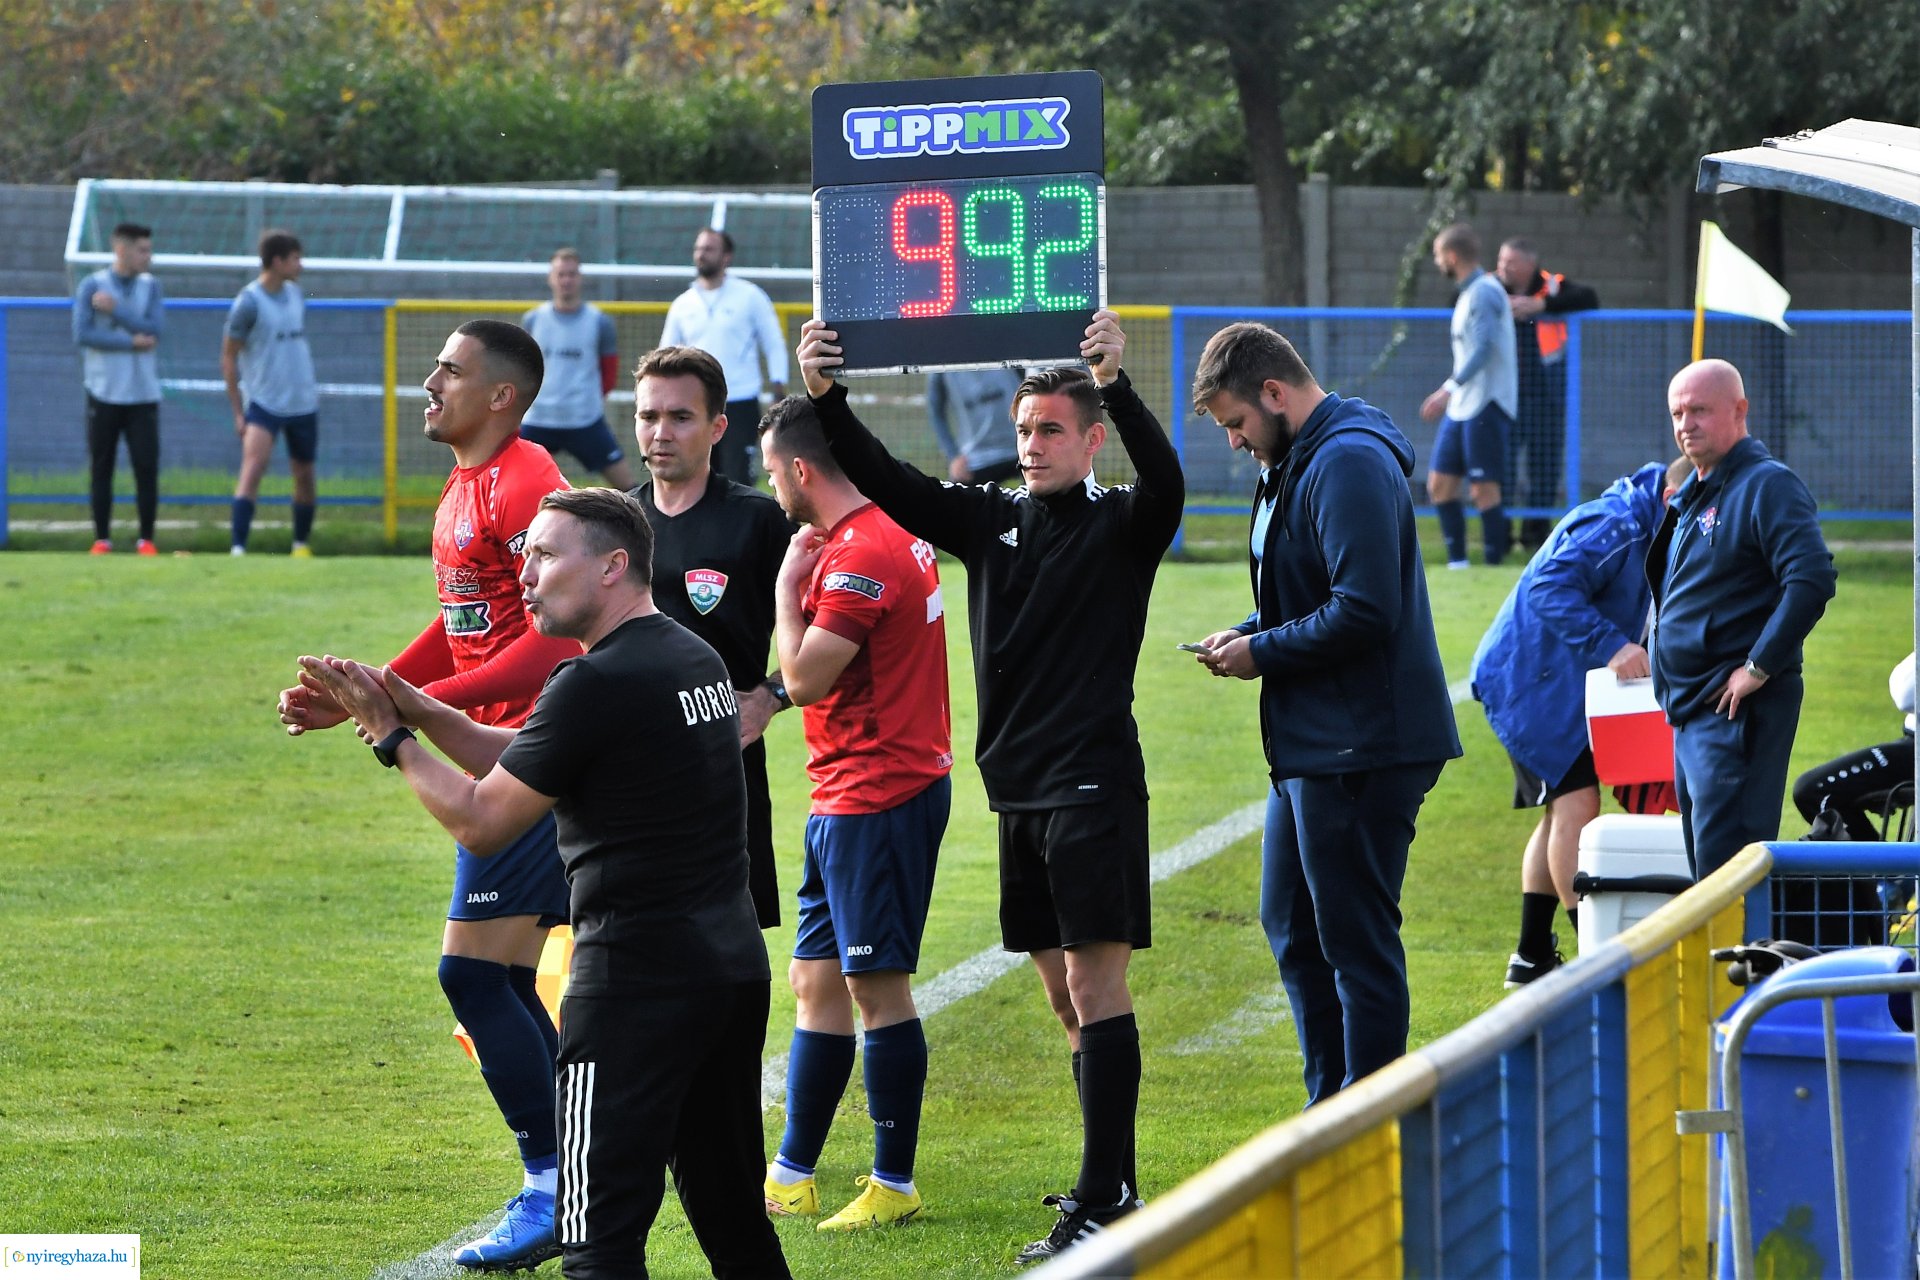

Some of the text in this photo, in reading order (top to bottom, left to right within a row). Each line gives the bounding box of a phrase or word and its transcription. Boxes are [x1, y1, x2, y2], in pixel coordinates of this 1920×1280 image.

[893, 184, 1093, 317] 9 92
[695, 573, 719, 582] MLSZ
[467, 891, 499, 904] JAKO
[847, 945, 873, 957] JAKO
[873, 1120, 895, 1128] AKO
